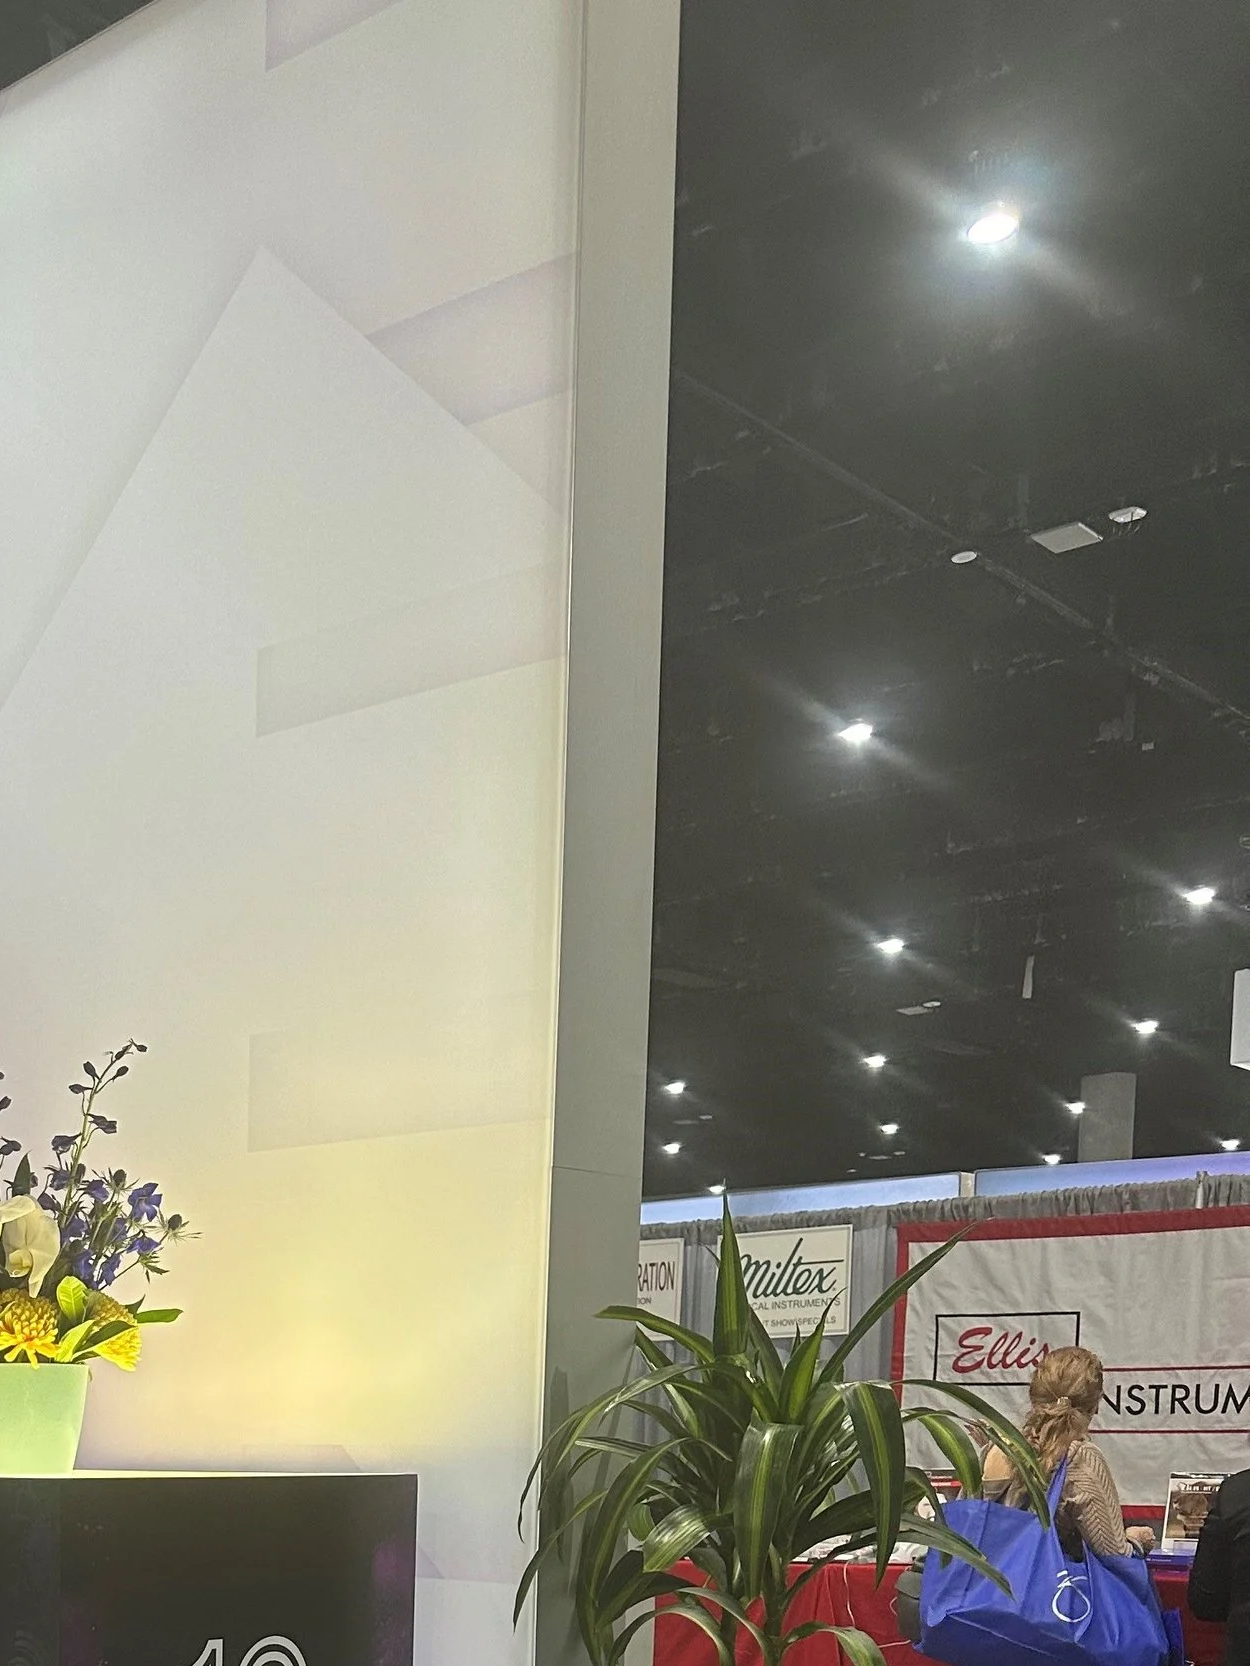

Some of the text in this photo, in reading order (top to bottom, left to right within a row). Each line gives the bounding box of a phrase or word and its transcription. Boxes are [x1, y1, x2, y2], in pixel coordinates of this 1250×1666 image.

[637, 1261, 676, 1292] RATION
[797, 1315, 837, 1326] SPECLS
[1100, 1382, 1250, 1416] NSTRUM
